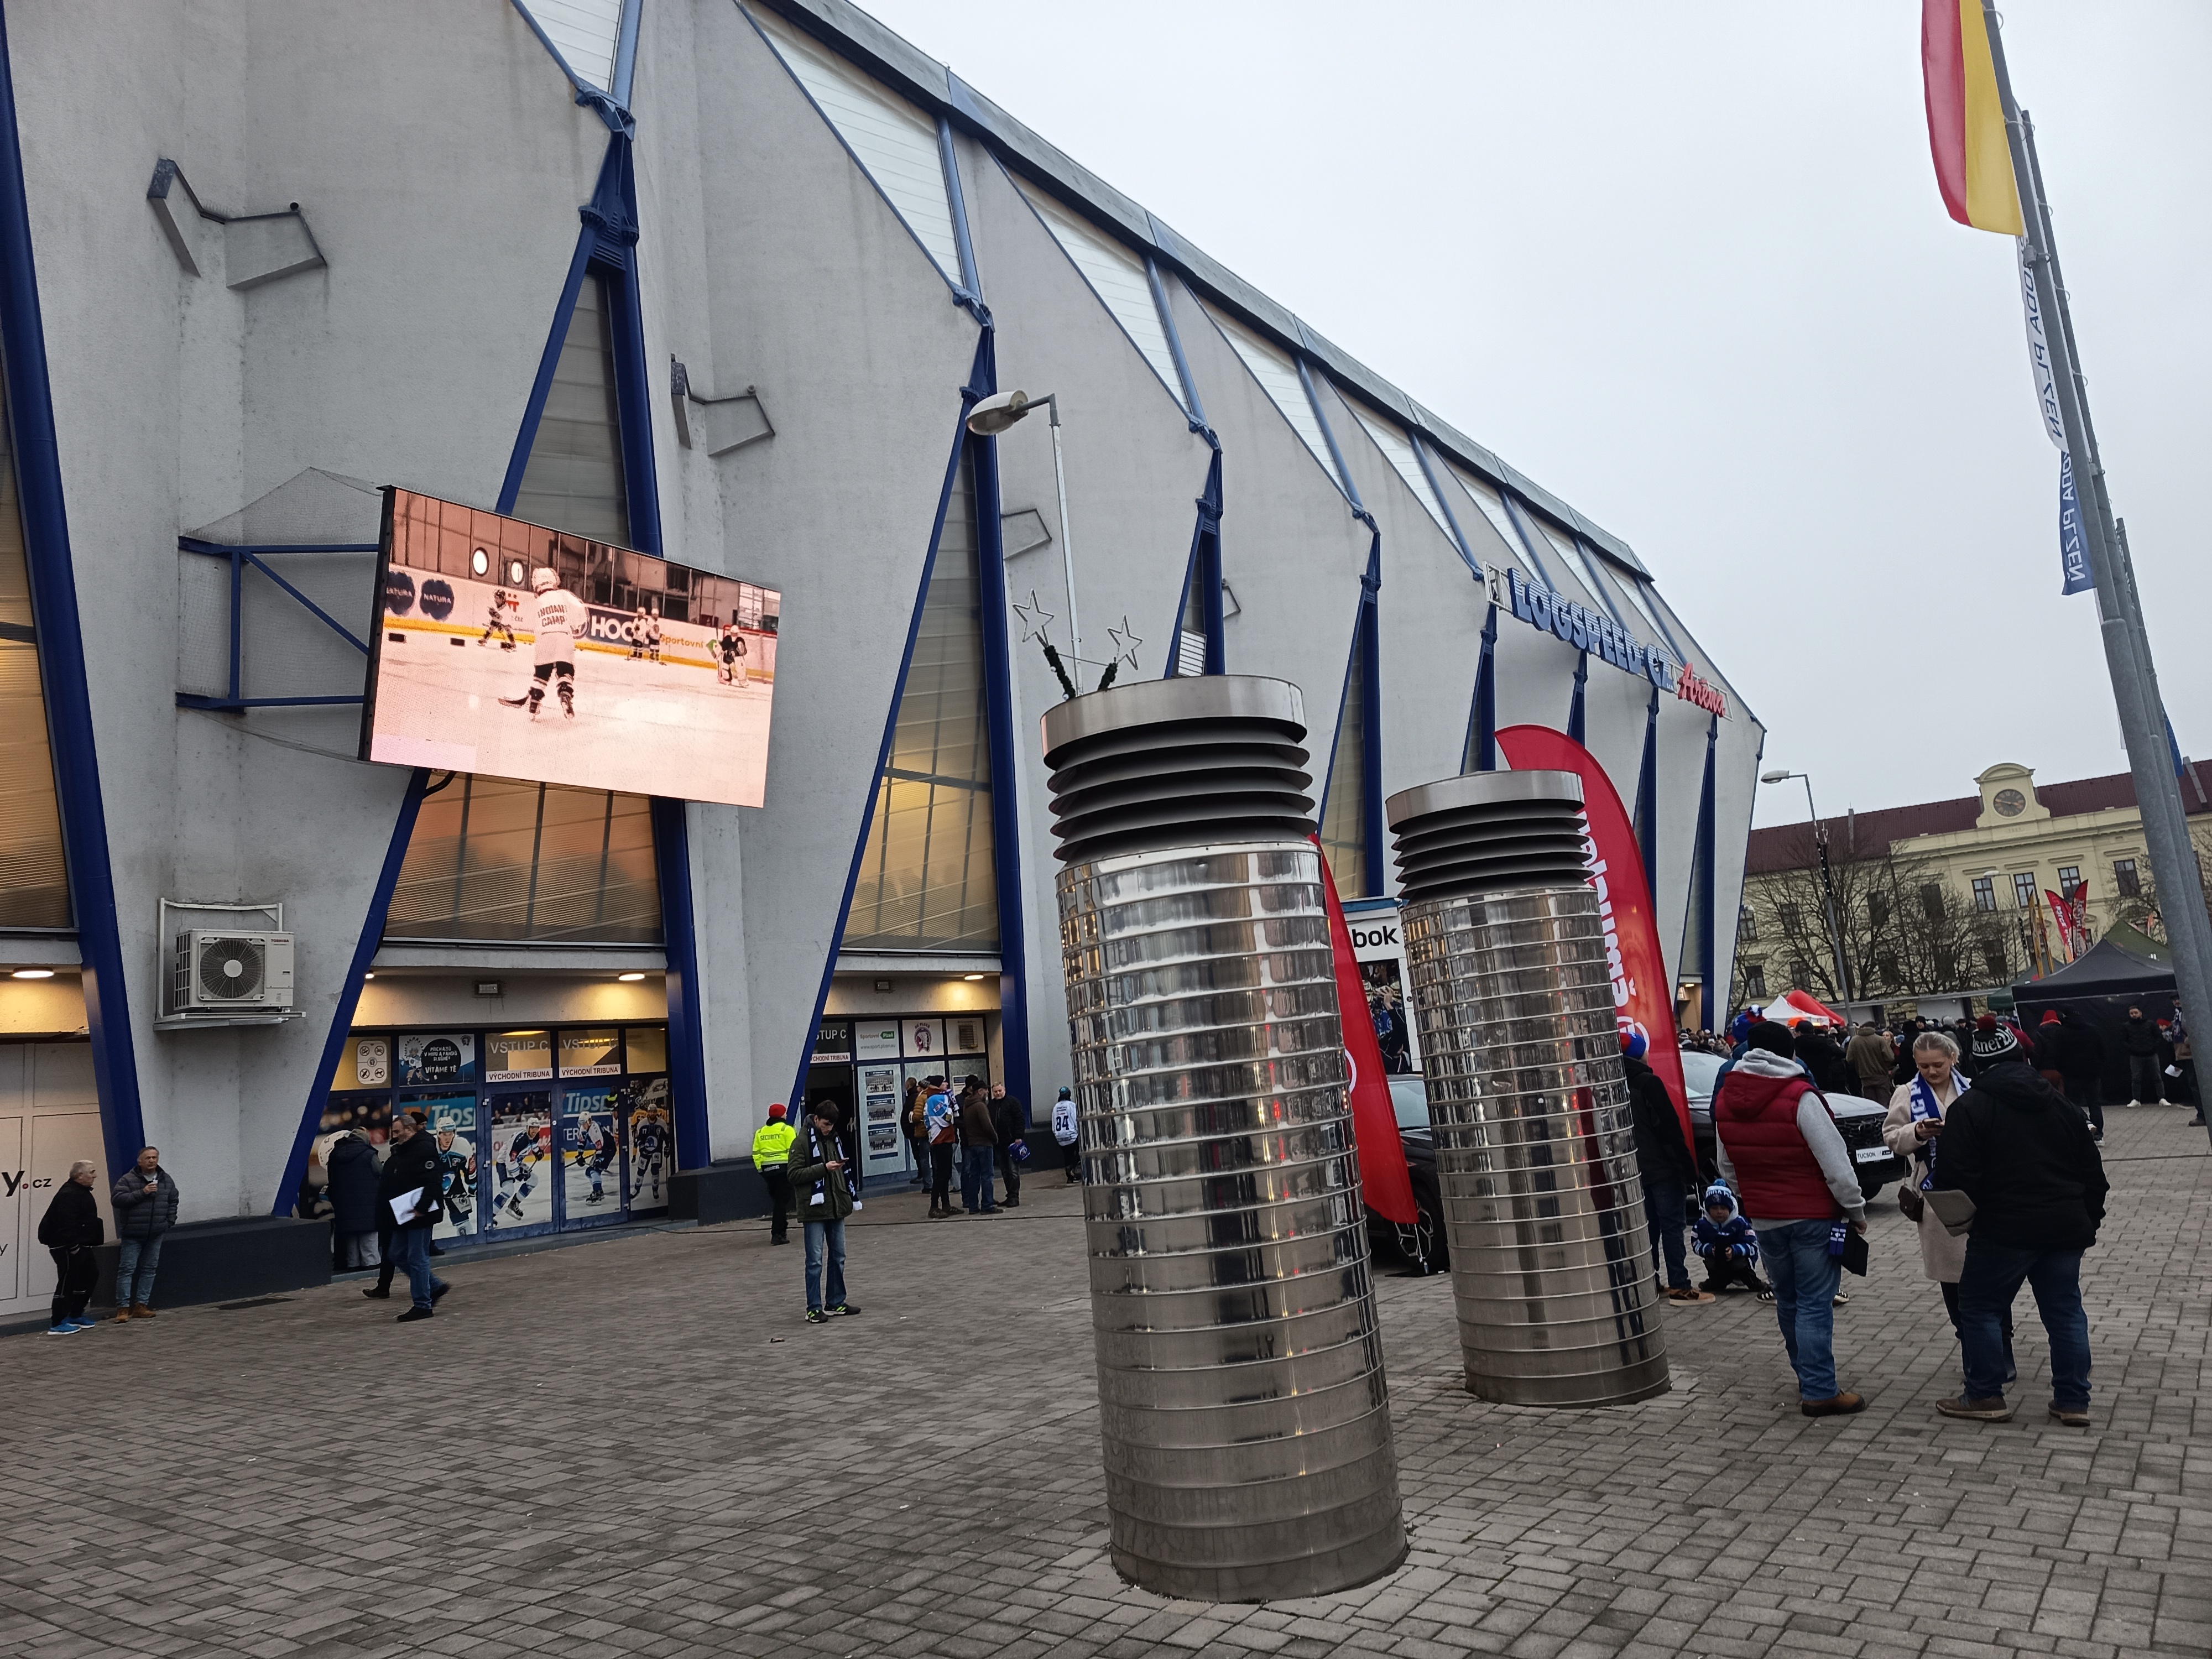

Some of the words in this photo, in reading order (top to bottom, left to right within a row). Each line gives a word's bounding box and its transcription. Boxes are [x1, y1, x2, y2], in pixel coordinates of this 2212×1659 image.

[424, 593, 451, 603] NATURA
[541, 615, 566, 627] CAMP
[1507, 567, 1642, 675] LOGSPEED
[591, 615, 641, 644] HOC
[1352, 925, 1400, 948] bok
[816, 1029, 838, 1041] TUP
[840, 1029, 847, 1039] C
[490, 1040, 535, 1053] VSTUP
[539, 1040, 549, 1051] C
[562, 1038, 604, 1050] VSTUP
[425, 1065, 448, 1073] VÍTÁME
[561, 1066, 592, 1076] VÝCHODNÍ
[489, 1070, 522, 1081] VÝCHODNÍ
[523, 1070, 550, 1078] TRIBUNA
[432, 1104, 476, 1126] Tips
[1056, 1115, 1070, 1131] 84
[1857, 1151, 1876, 1160] TUCSON
[1, 1170, 52, 1197] y.cz
